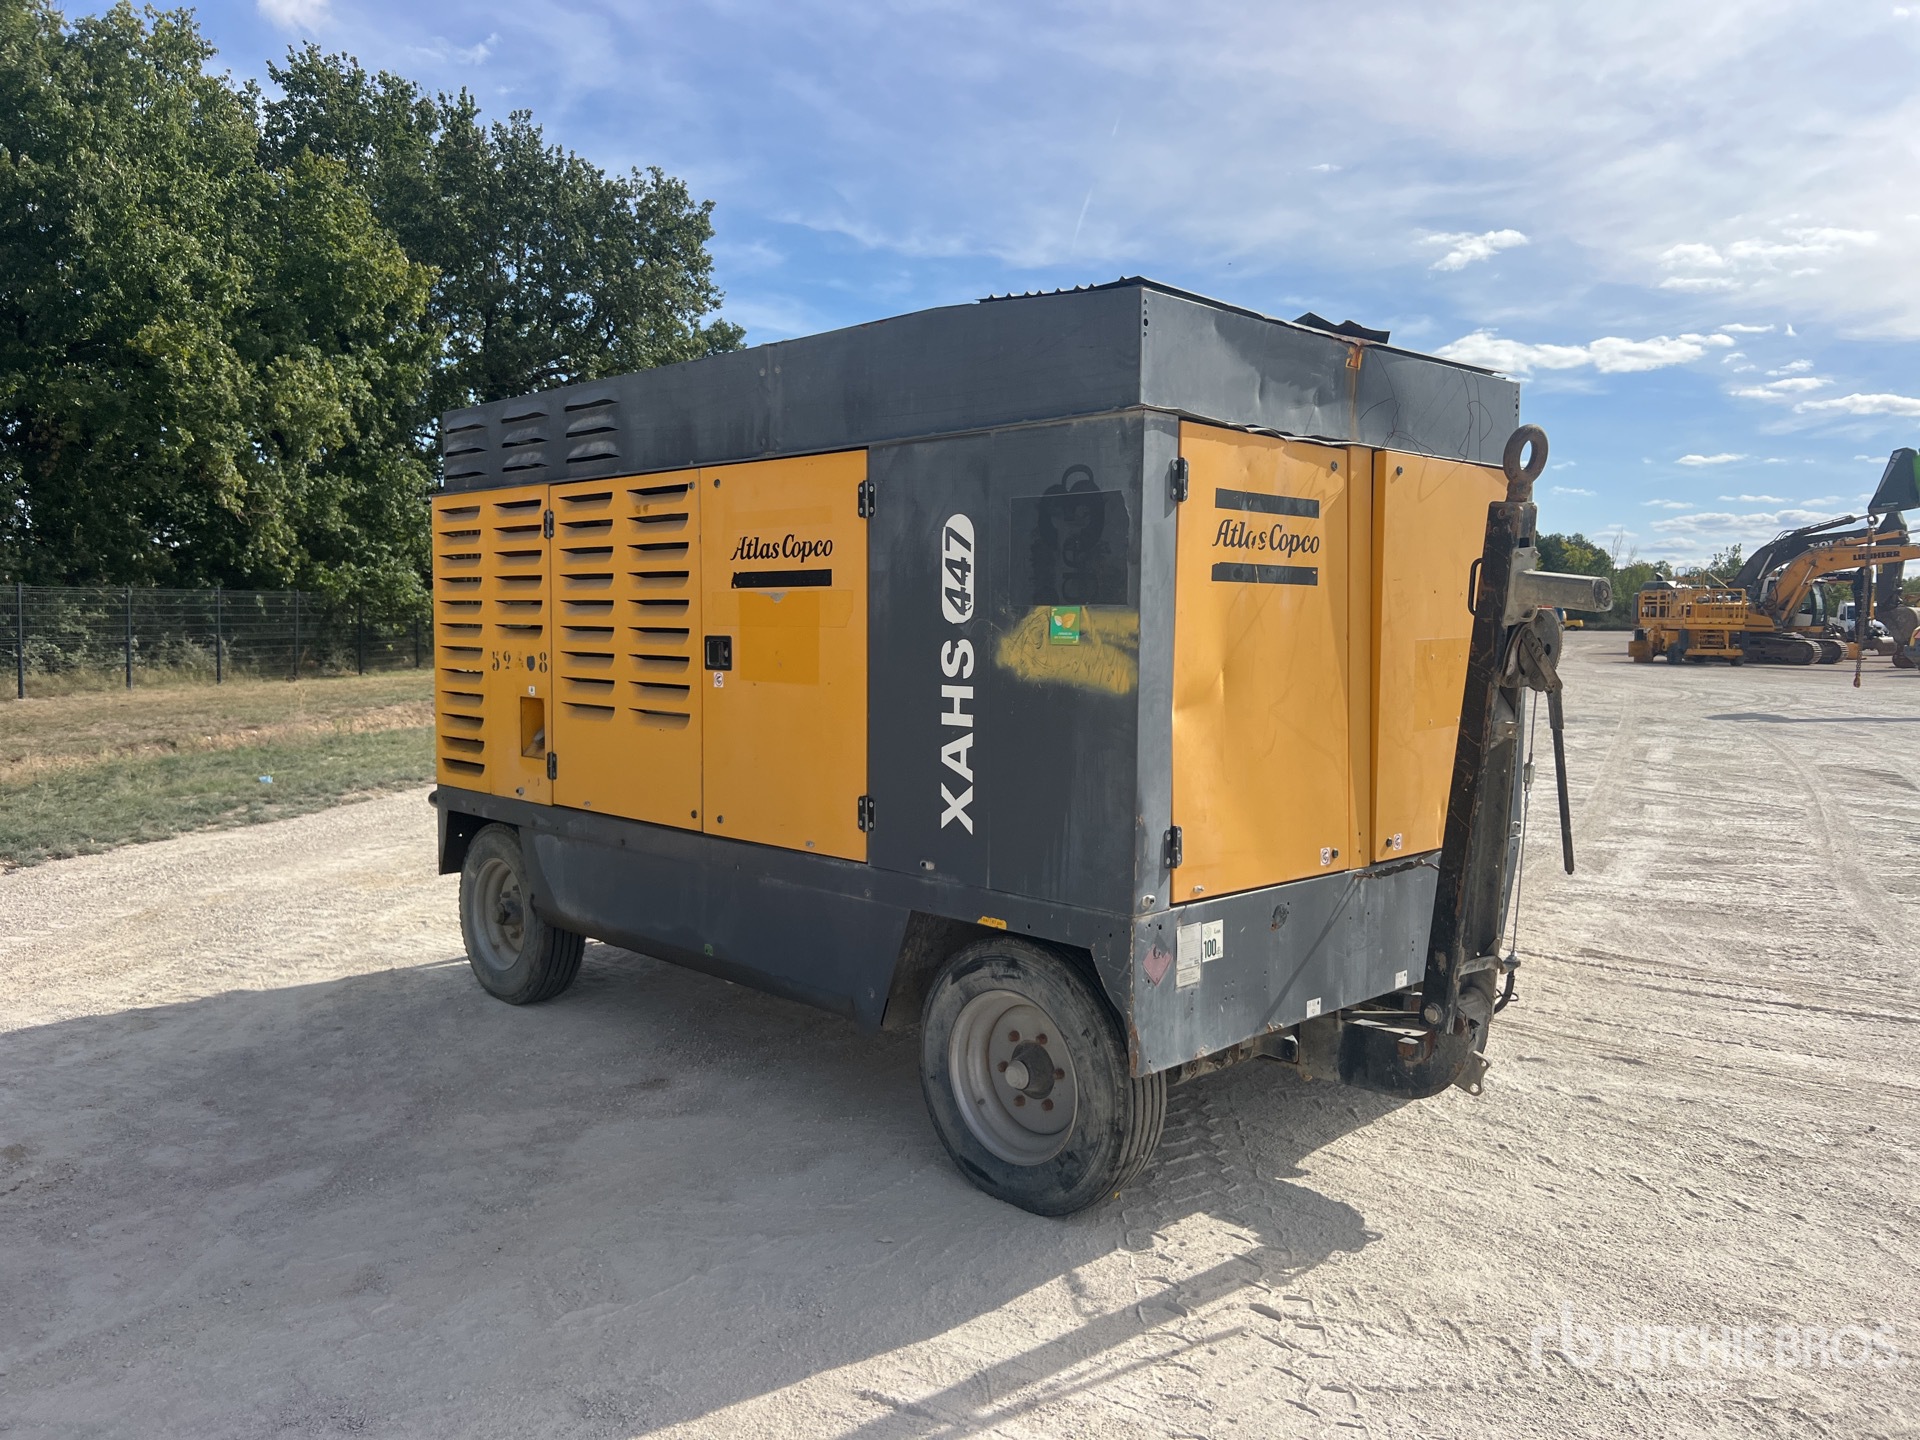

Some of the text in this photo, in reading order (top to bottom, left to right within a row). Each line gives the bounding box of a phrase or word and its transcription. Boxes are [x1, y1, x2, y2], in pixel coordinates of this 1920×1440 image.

[730, 534, 833, 563] Atlas Copco
[1212, 519, 1320, 558] Atlas Copco
[1853, 550, 1900, 561] LIEHERR
[940, 526, 975, 836] XAHS 447
[1203, 938, 1217, 959] 100
